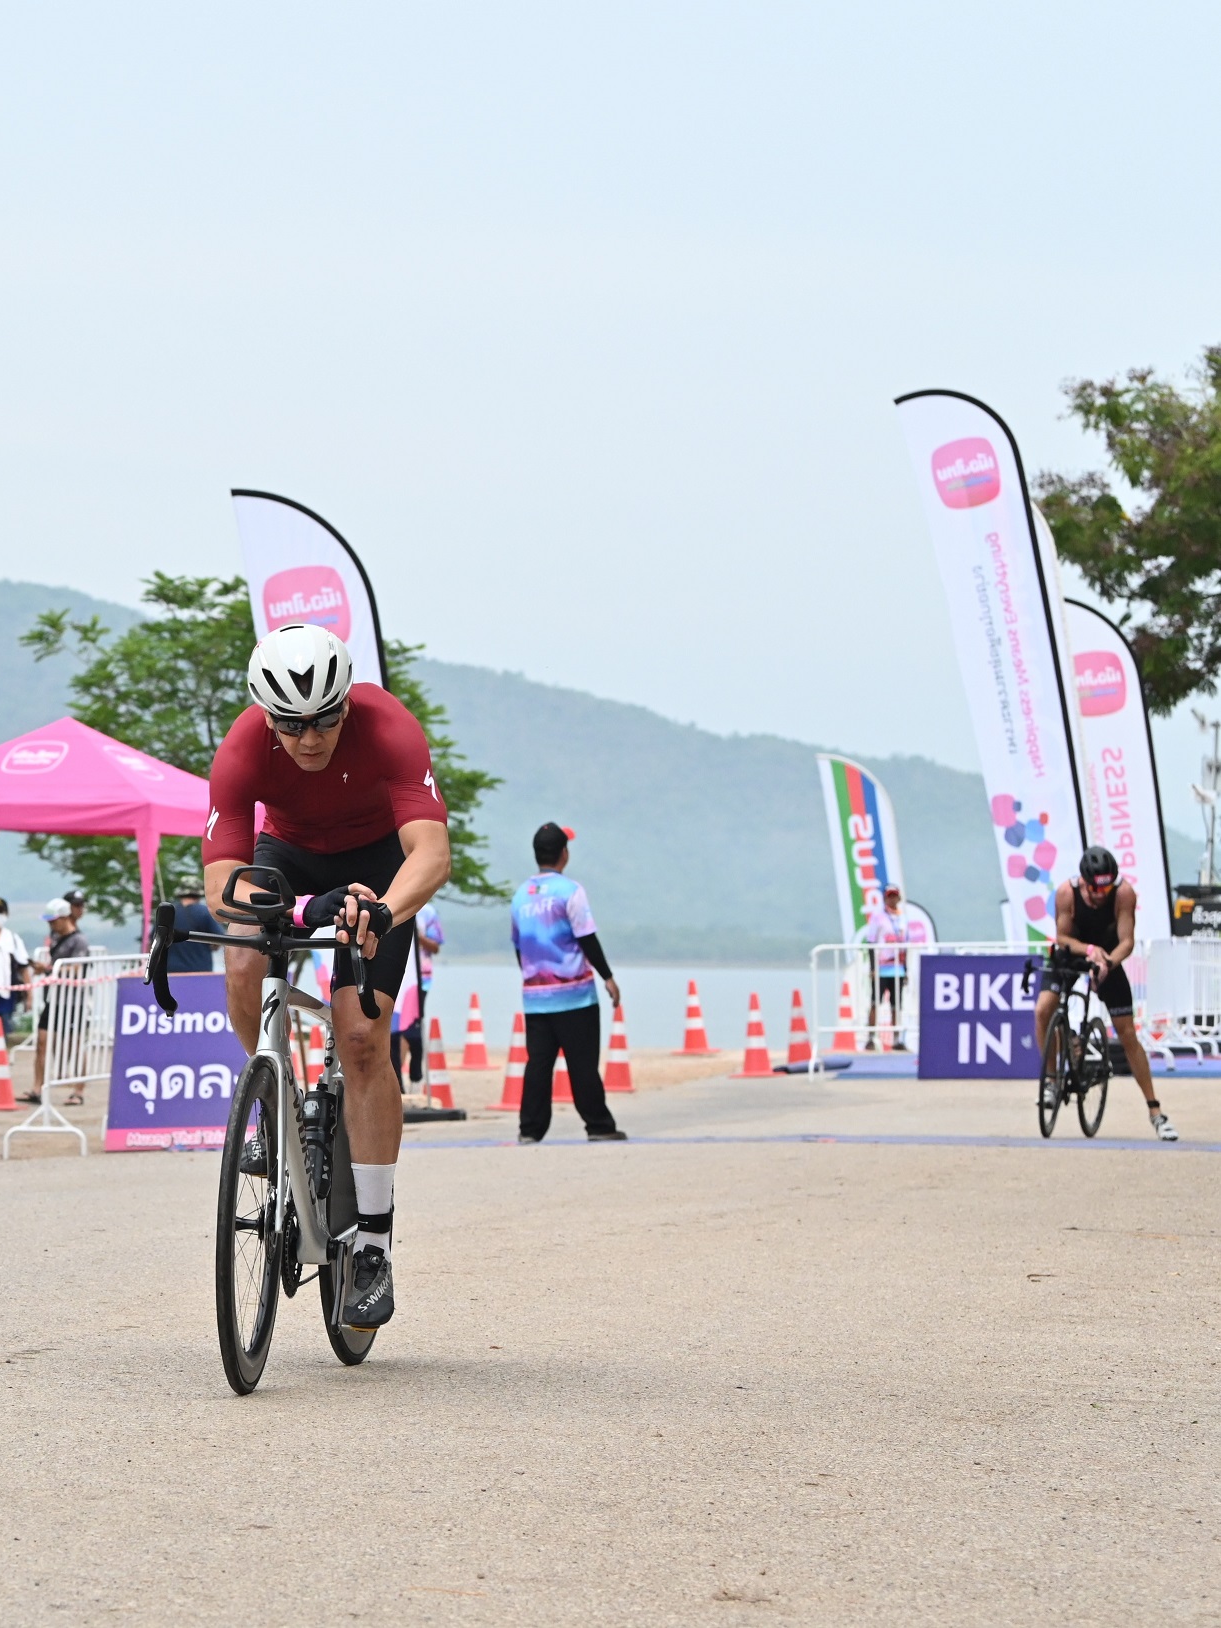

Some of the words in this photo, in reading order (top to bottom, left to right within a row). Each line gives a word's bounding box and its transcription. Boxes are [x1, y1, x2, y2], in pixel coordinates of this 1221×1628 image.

[934, 973, 1036, 1011] BIKE
[958, 1021, 1012, 1066] IN
[125, 1063, 238, 1115] จุดล
